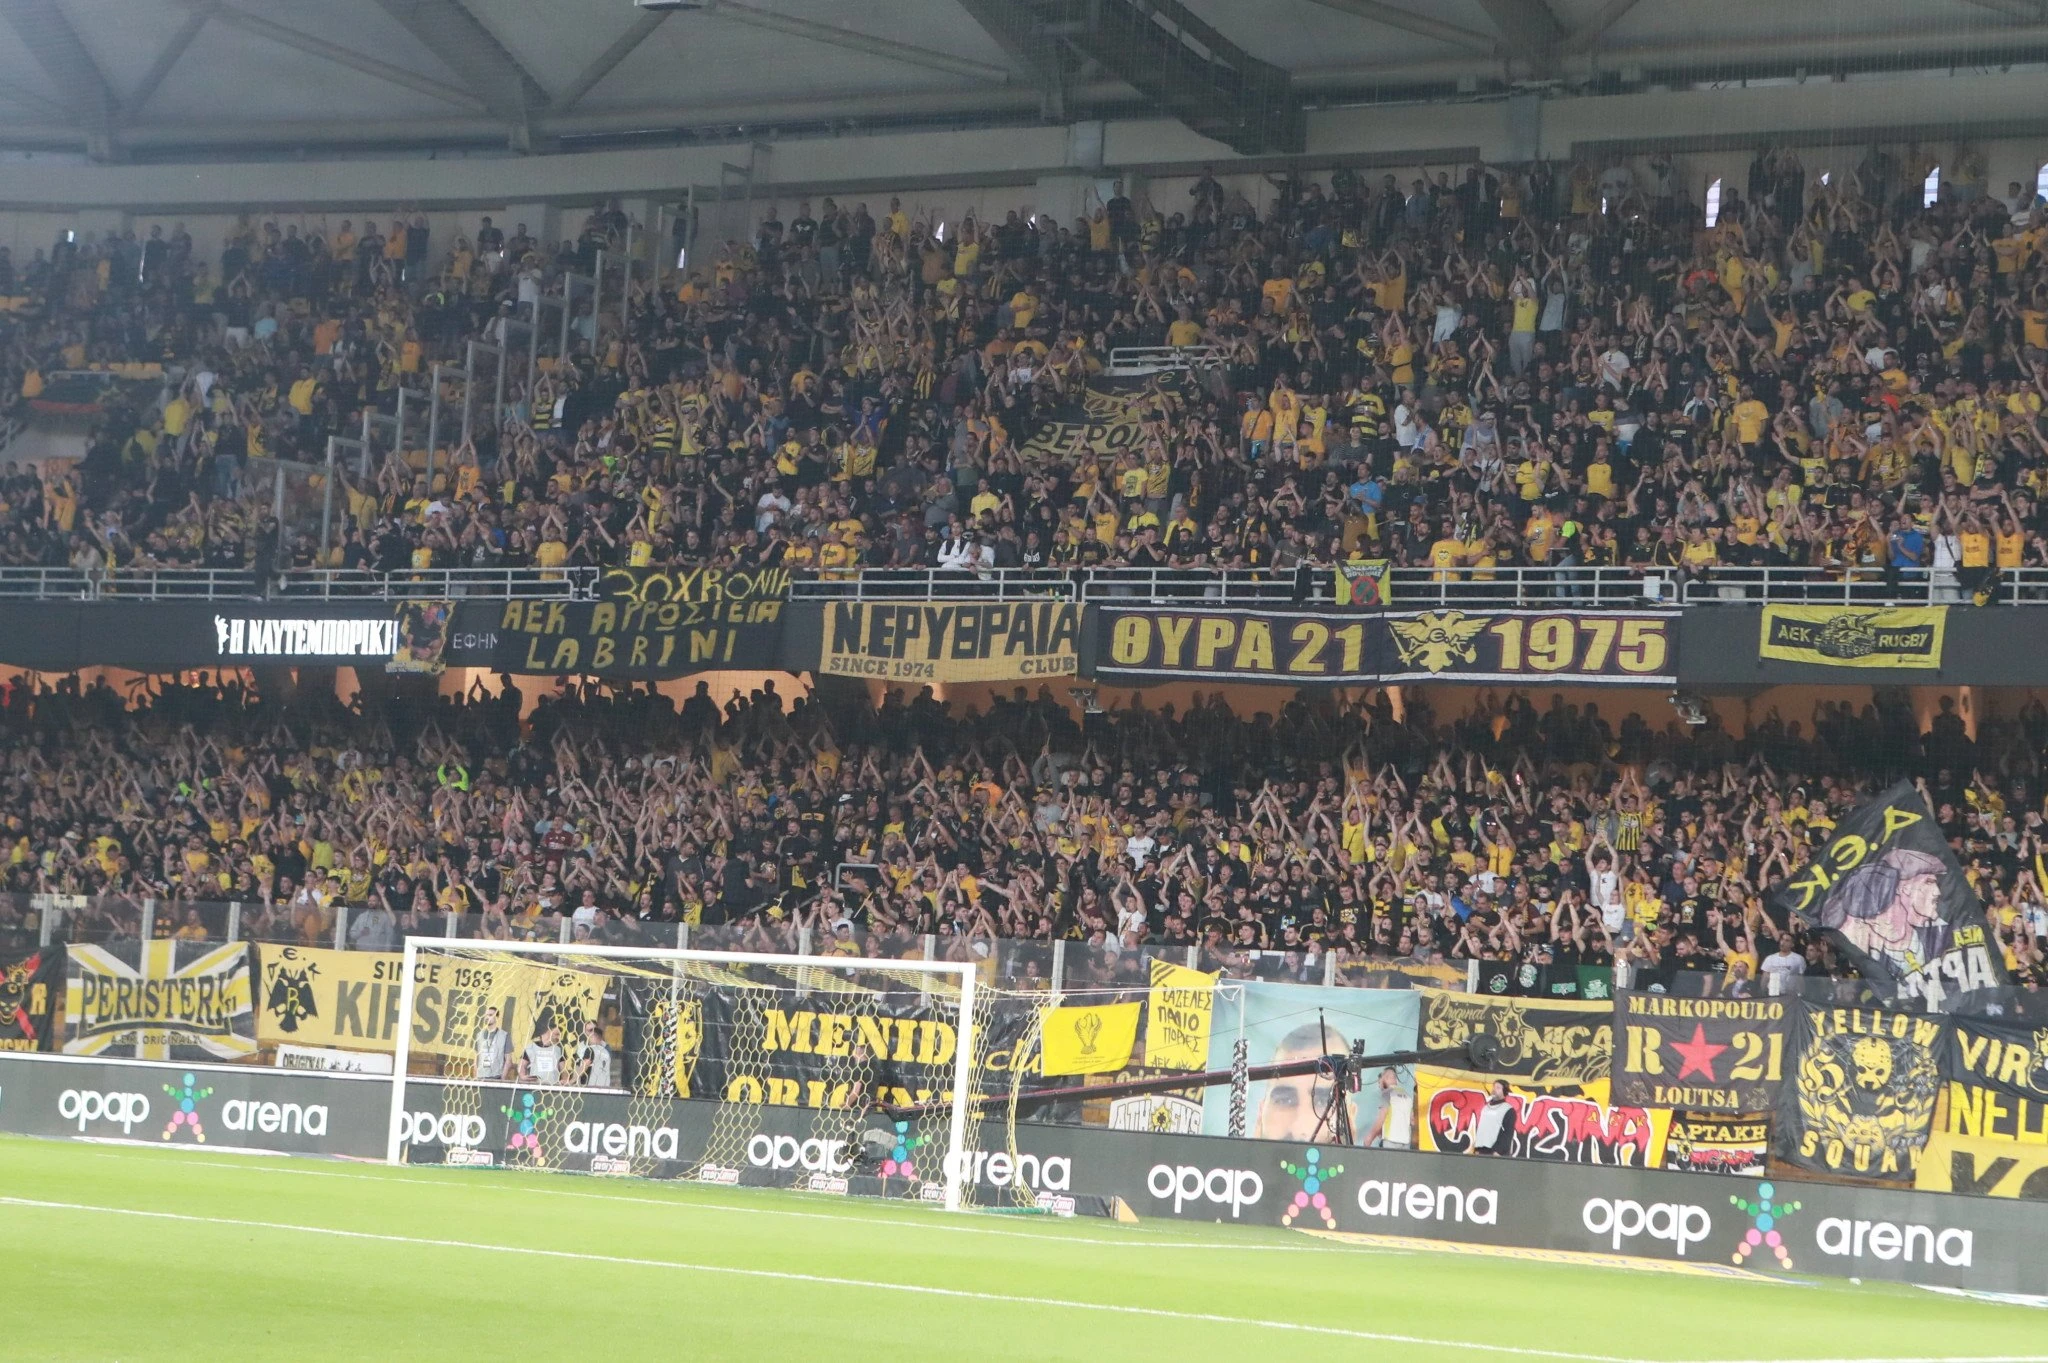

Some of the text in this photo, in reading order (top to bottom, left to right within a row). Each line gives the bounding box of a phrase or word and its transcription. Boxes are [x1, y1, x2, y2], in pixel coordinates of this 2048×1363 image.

[228, 619, 246, 655] Η
[526, 627, 737, 670] LABRINI
[1288, 622, 1364, 672] 21
[1489, 617, 1669, 673] 1975
[1778, 624, 1929, 649] AEK RUGBY
[829, 656, 935, 678] SINCE 1974
[1020, 656, 1076, 675] CLUB
[1628, 996, 1784, 1020] MARKOPOULO
[1810, 1008, 1941, 1048] YELLOW
[1625, 1025, 1783, 1081] R 21
[58, 1089, 329, 1136] opap arena
[1655, 1086, 1739, 1108] LOUTSA
[563, 1121, 680, 1159] arena
[943, 1150, 1072, 1191] rena
[1147, 1164, 1499, 1225] opap arena
[1582, 1197, 1974, 1268] opap arena
